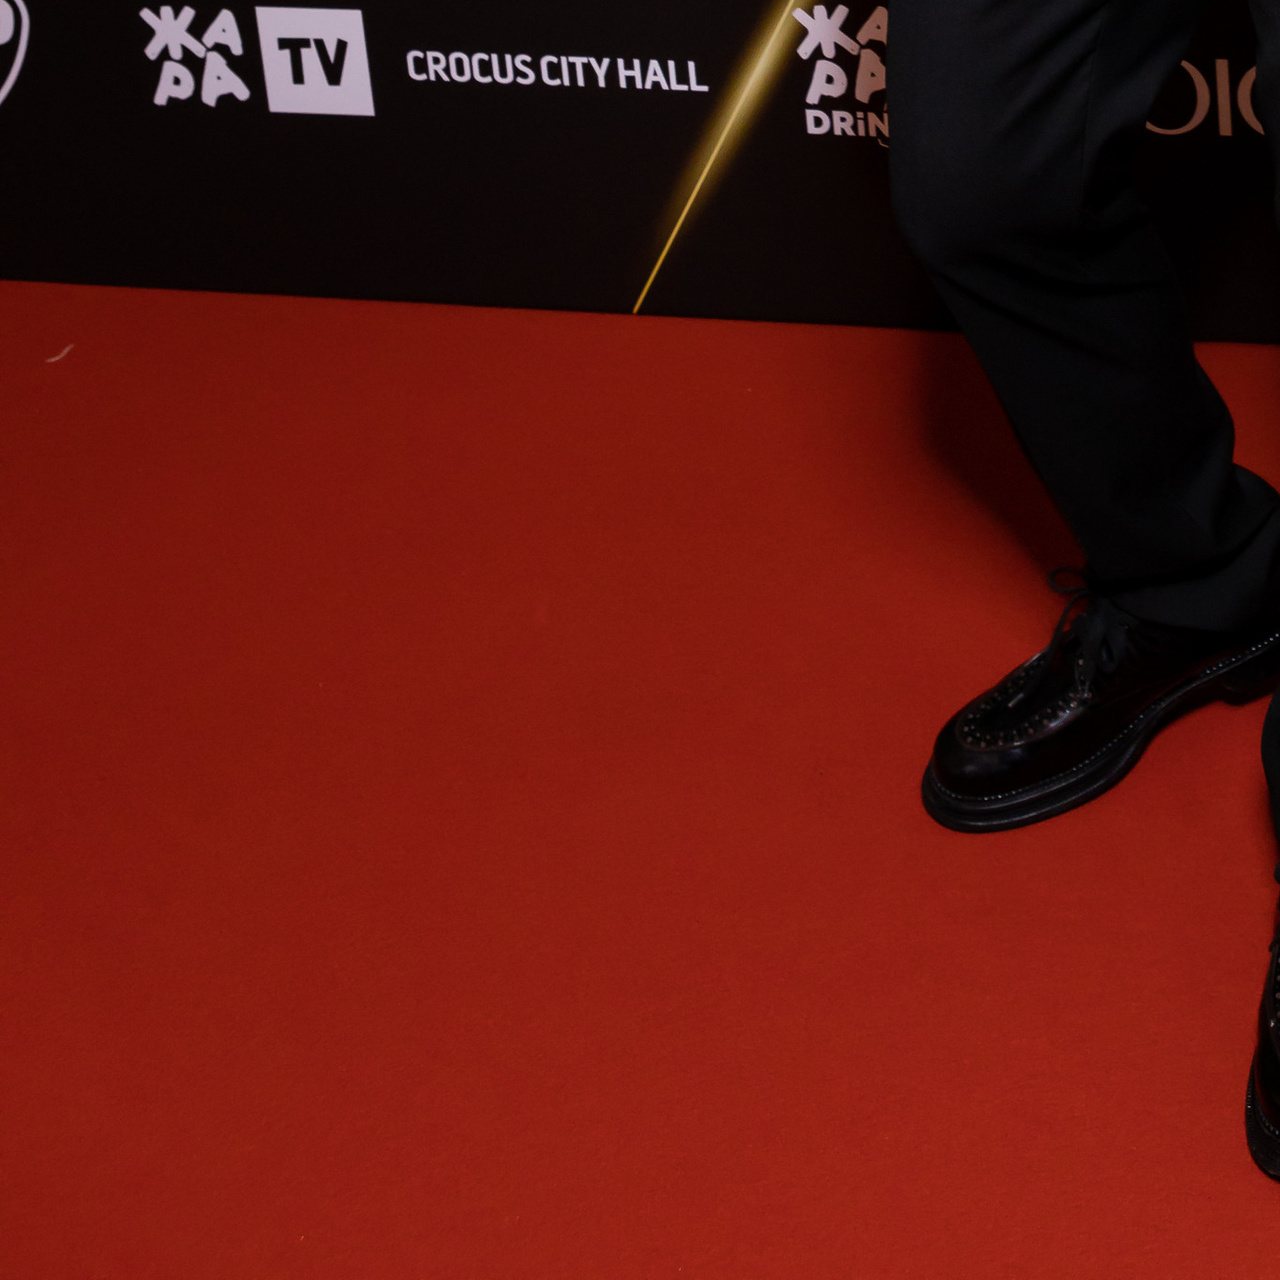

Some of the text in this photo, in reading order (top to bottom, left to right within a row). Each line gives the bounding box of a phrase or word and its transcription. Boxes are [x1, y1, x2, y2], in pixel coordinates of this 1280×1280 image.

[277, 37, 348, 87] TV
[406, 50, 709, 92] CROCUS CITY HALL
